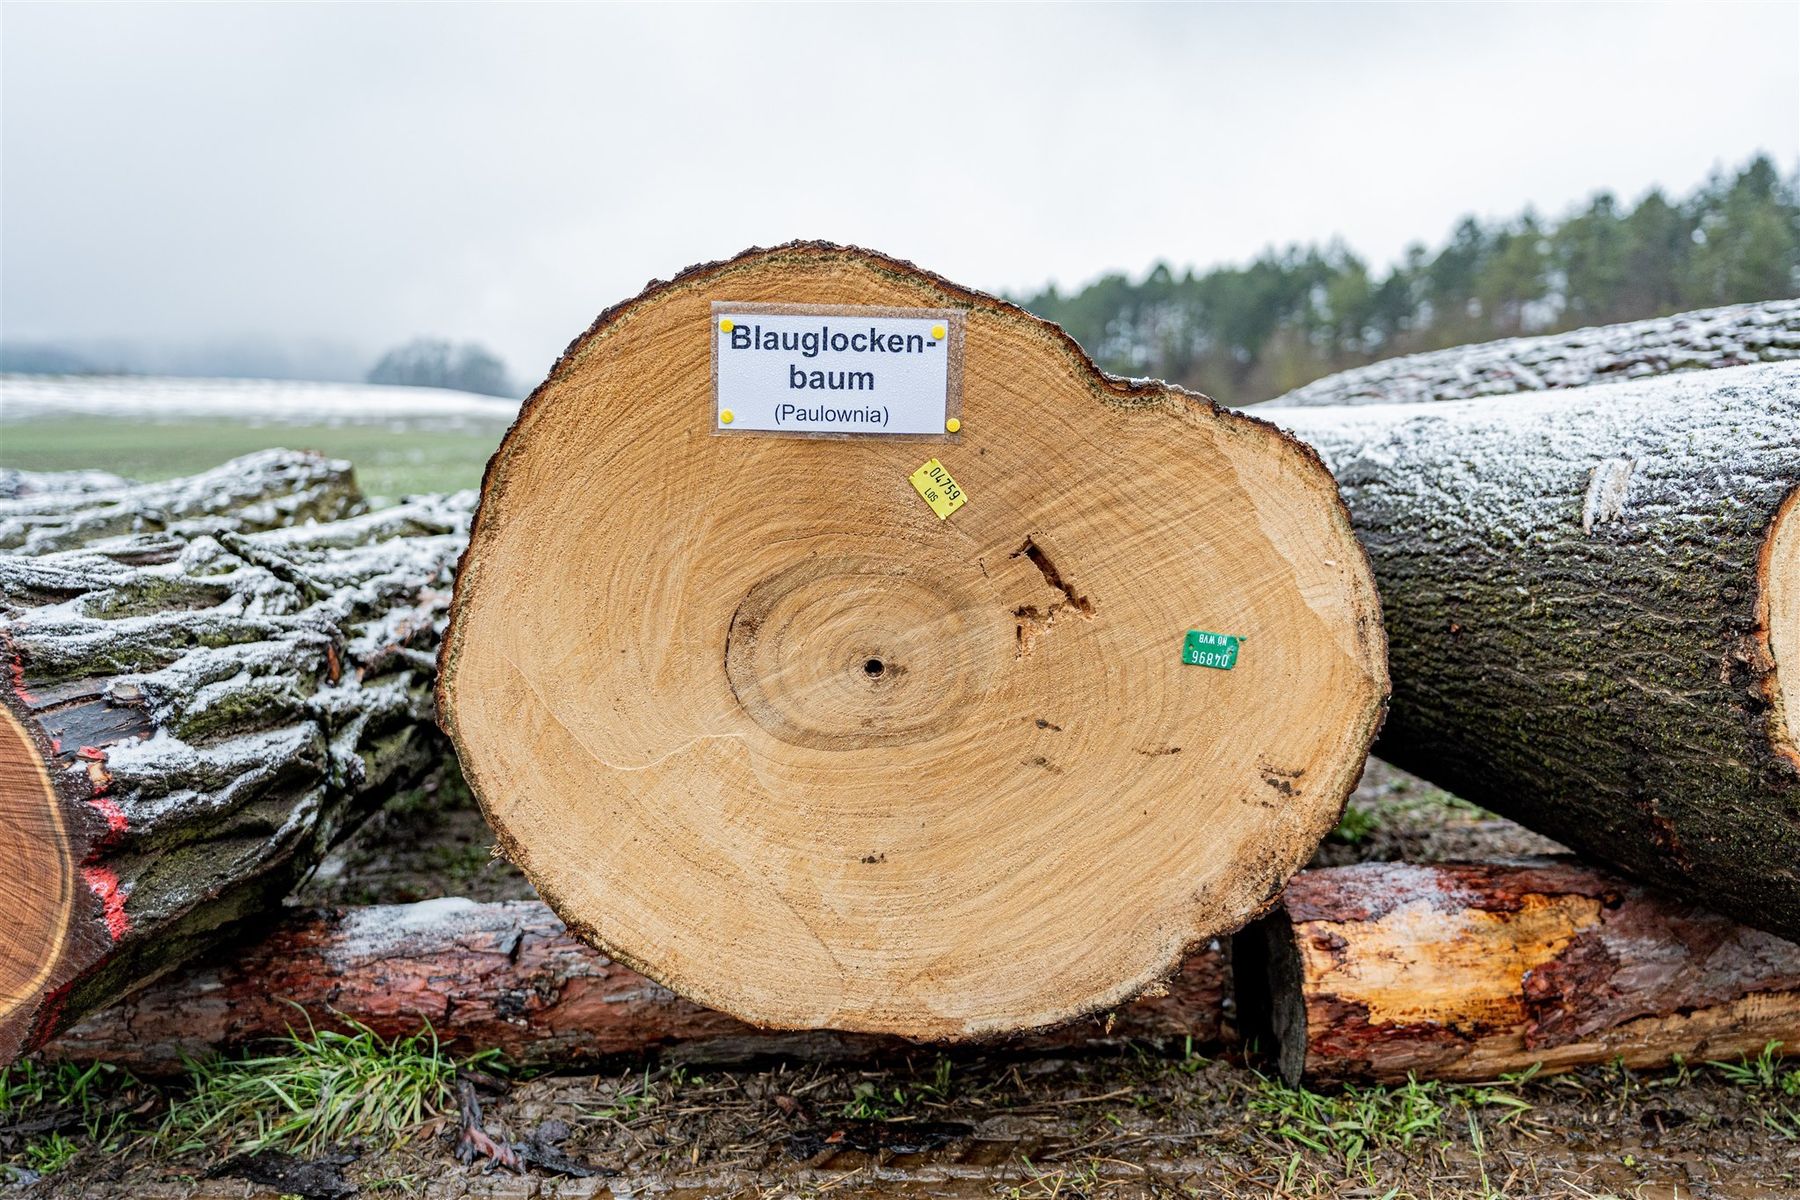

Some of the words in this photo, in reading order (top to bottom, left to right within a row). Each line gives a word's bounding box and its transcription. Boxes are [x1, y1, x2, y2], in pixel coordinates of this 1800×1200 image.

[731, 324, 937, 358] Blauglocken-
[790, 364, 875, 391] baum
[774, 404, 889, 427] (Paulownia)
[924, 487, 939, 503] LOS
[929, 467, 961, 501] 04759
[1198, 633, 1216, 645] WVB
[1191, 650, 1230, 667] 04896
